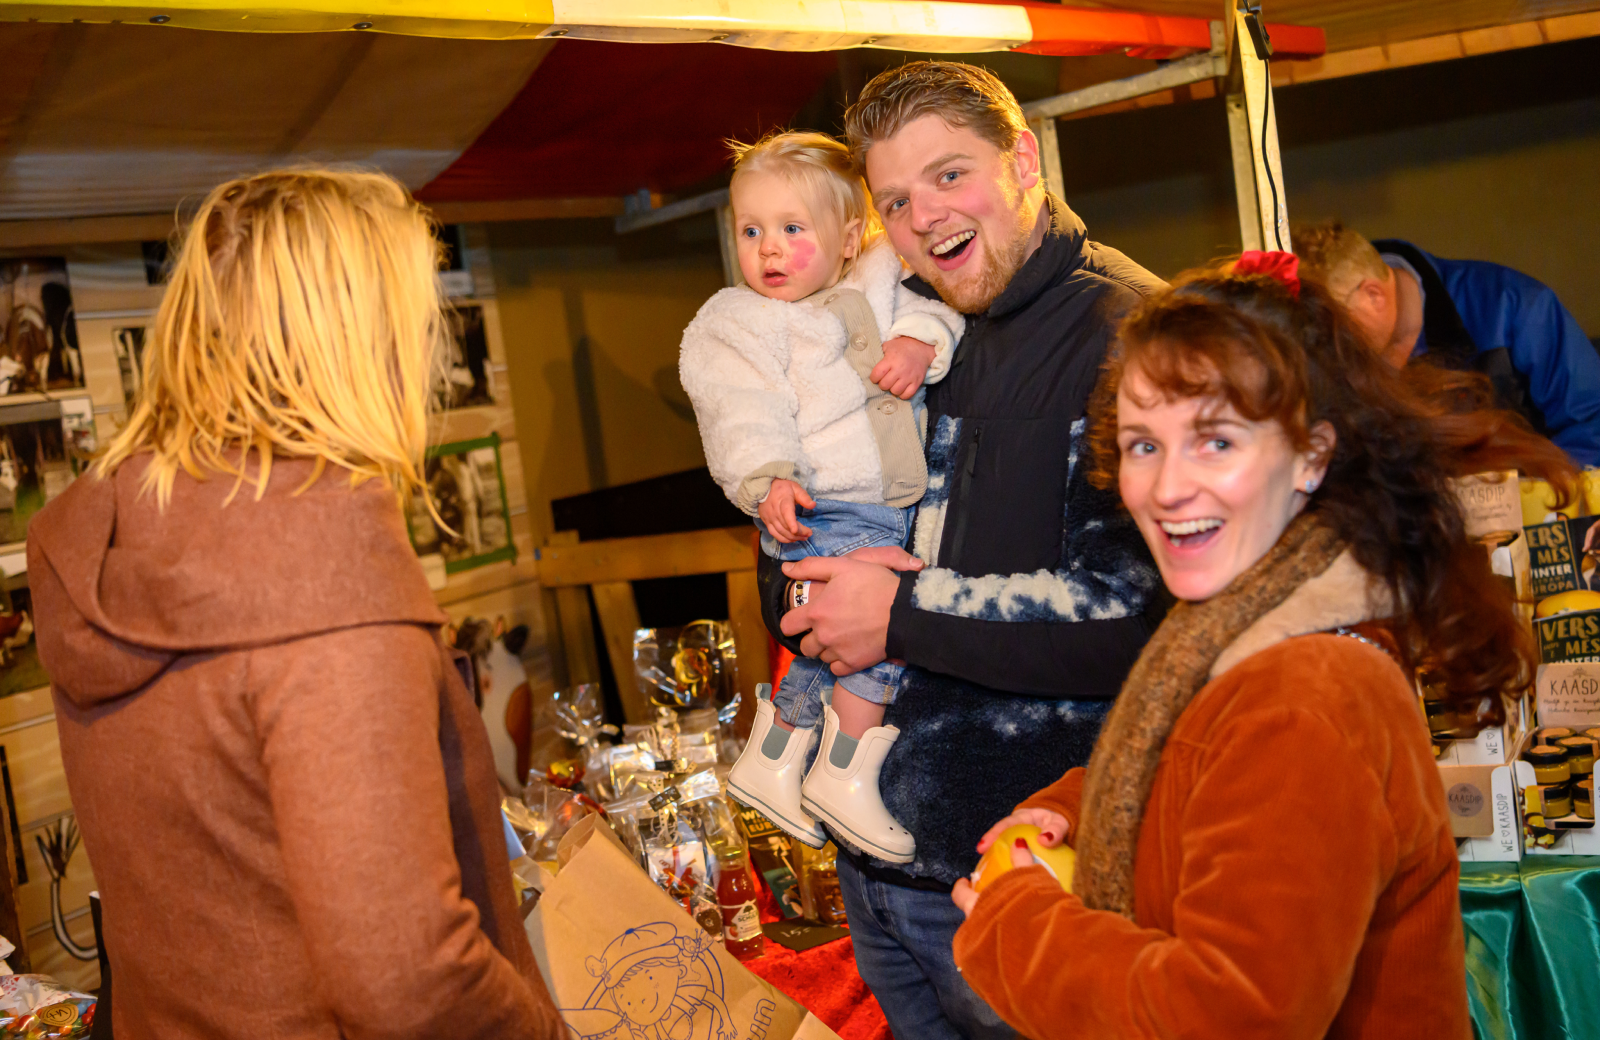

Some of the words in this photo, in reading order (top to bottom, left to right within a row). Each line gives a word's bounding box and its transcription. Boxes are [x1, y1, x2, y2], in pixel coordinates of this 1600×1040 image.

[1526, 524, 1566, 548] ERS
[1531, 563, 1572, 579] INTER
[1533, 580, 1575, 595] UROPA
[1542, 615, 1599, 641] VERS
[1550, 679, 1599, 696] KAASD
[1486, 742, 1498, 755] WE
[1448, 793, 1482, 805] KAASDIP
[1496, 793, 1510, 828] KAASDIP
[748, 821, 773, 833] EUR
[1501, 839, 1513, 853] WE
